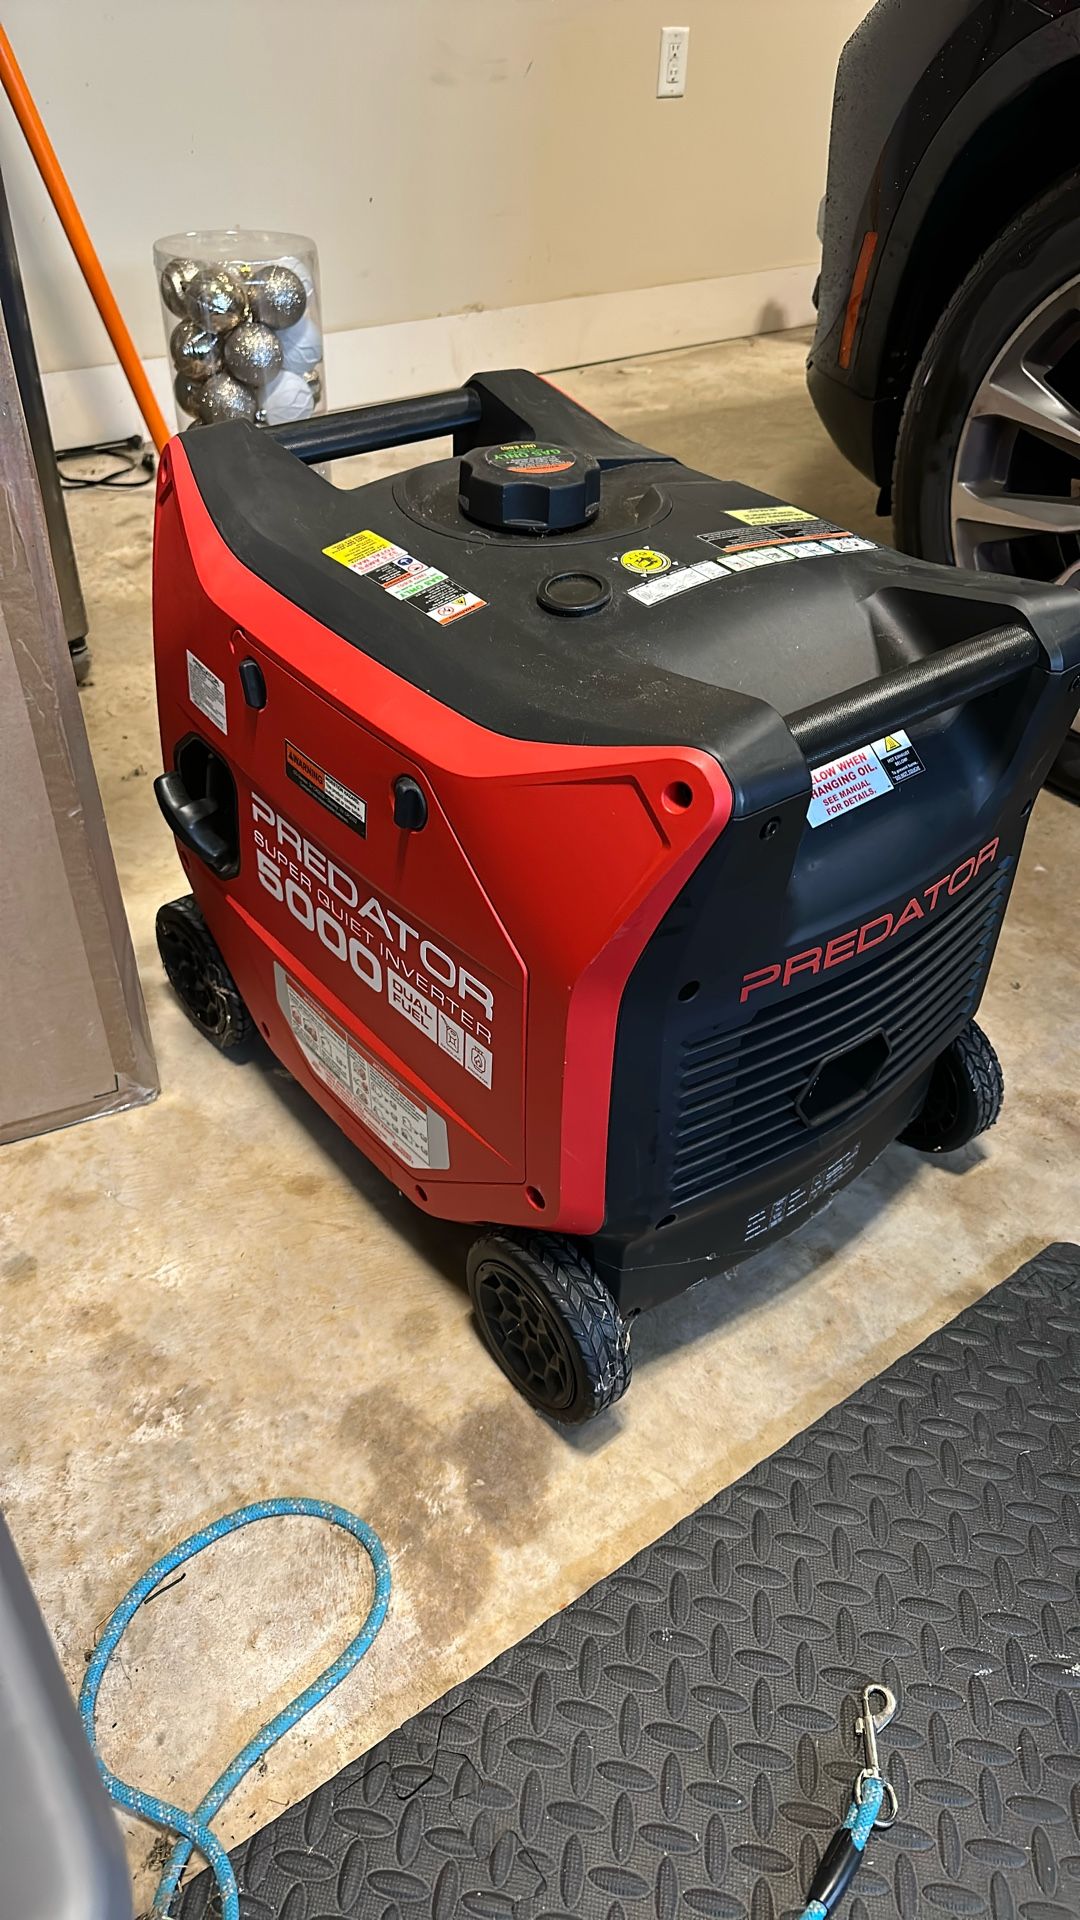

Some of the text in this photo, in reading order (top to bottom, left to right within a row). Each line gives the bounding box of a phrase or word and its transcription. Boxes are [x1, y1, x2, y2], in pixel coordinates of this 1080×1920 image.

[400, 584, 423, 598] ONLY
[424, 575, 443, 585] GAS
[291, 754, 323, 784] WARNING
[812, 752, 868, 785] LOW WHEN
[857, 763, 878, 777] OIL.
[822, 779, 871, 806] SEE MANUAL
[826, 788, 877, 816] FOR DETAILS.
[251, 791, 494, 1021] PREDATOR
[256, 848, 383, 993] 5000
[739, 836, 1000, 1004] PREDATOR
[254, 829, 312, 893] SUPER
[317, 888, 374, 945] QUIET
[380, 942, 492, 1045] INVERTER
[393, 978, 433, 1021] DUAL
[393, 991, 430, 1031] FUEL
